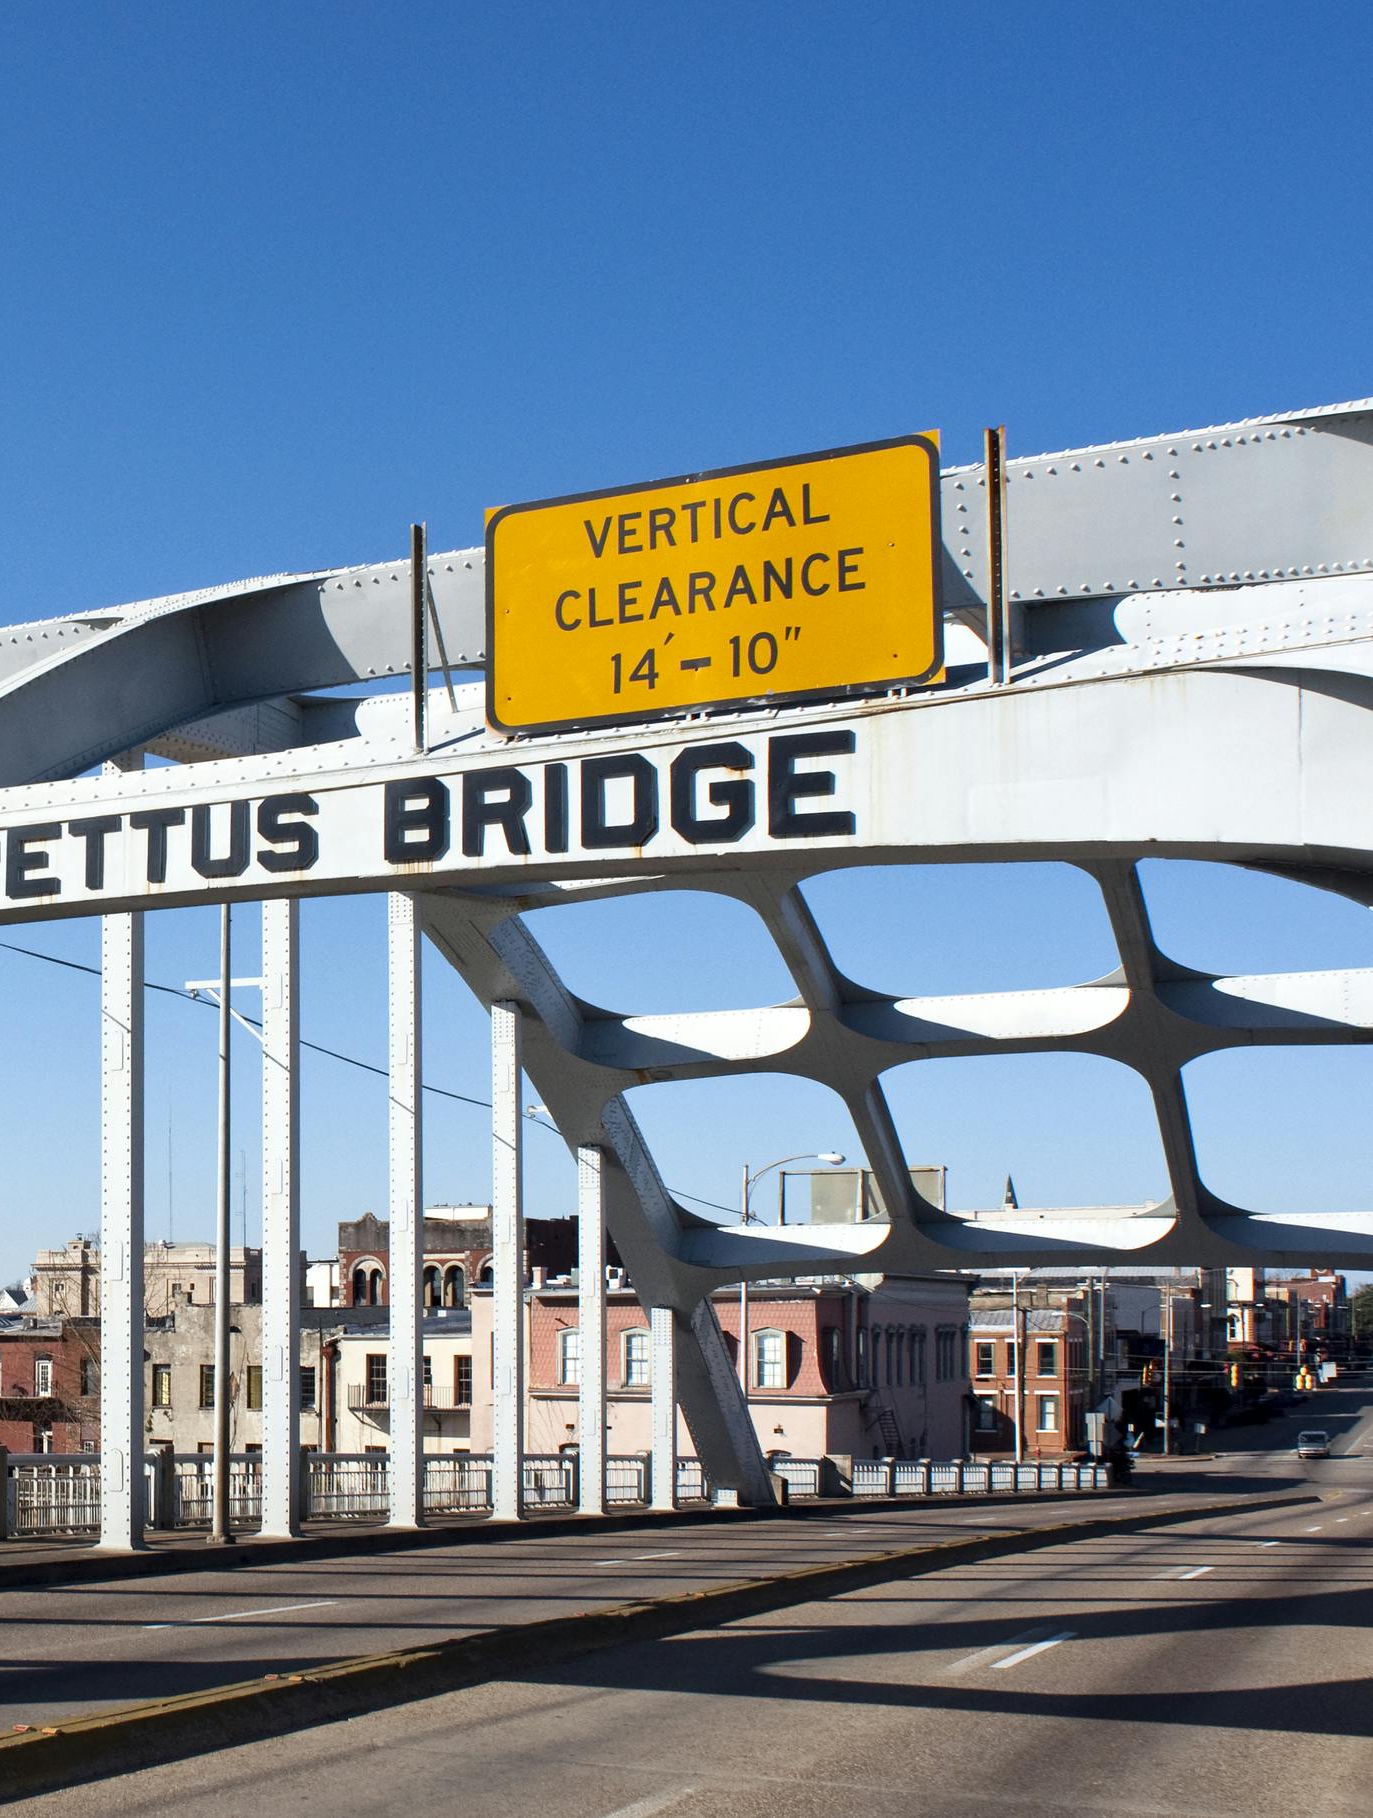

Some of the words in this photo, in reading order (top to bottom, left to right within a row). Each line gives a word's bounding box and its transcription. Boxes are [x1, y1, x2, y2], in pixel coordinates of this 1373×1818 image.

[583, 484, 830, 559] VERTICAL
[555, 547, 867, 632] CLEARANCE
[384, 729, 856, 864] BRIDGE
